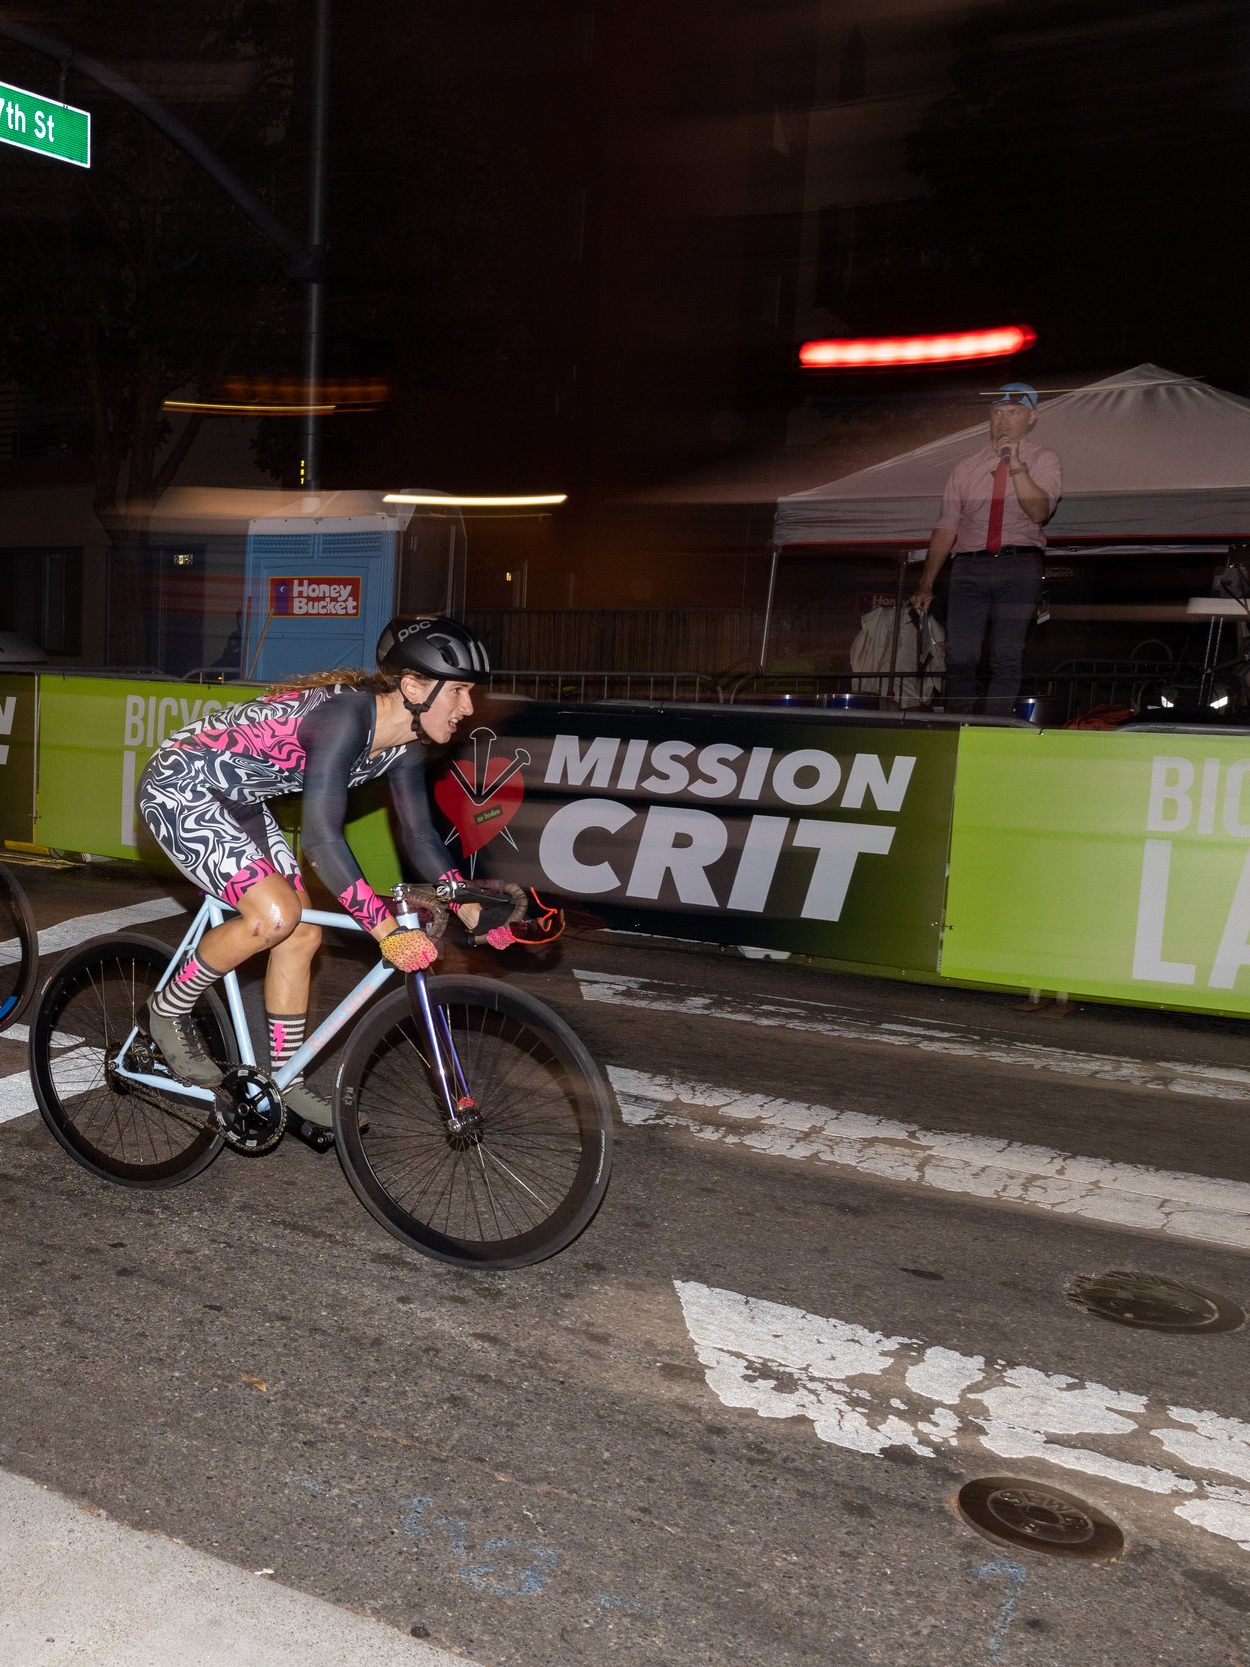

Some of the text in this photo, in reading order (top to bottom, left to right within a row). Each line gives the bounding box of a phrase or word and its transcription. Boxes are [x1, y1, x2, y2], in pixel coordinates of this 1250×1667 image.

[34, 110, 55, 142] St
[293, 579, 352, 600] Honey
[293, 597, 357, 615] Bucket
[398, 621, 431, 642] POC
[124, 694, 237, 748] BICY
[544, 734, 917, 812] MISSION
[539, 798, 896, 922] CRIT
